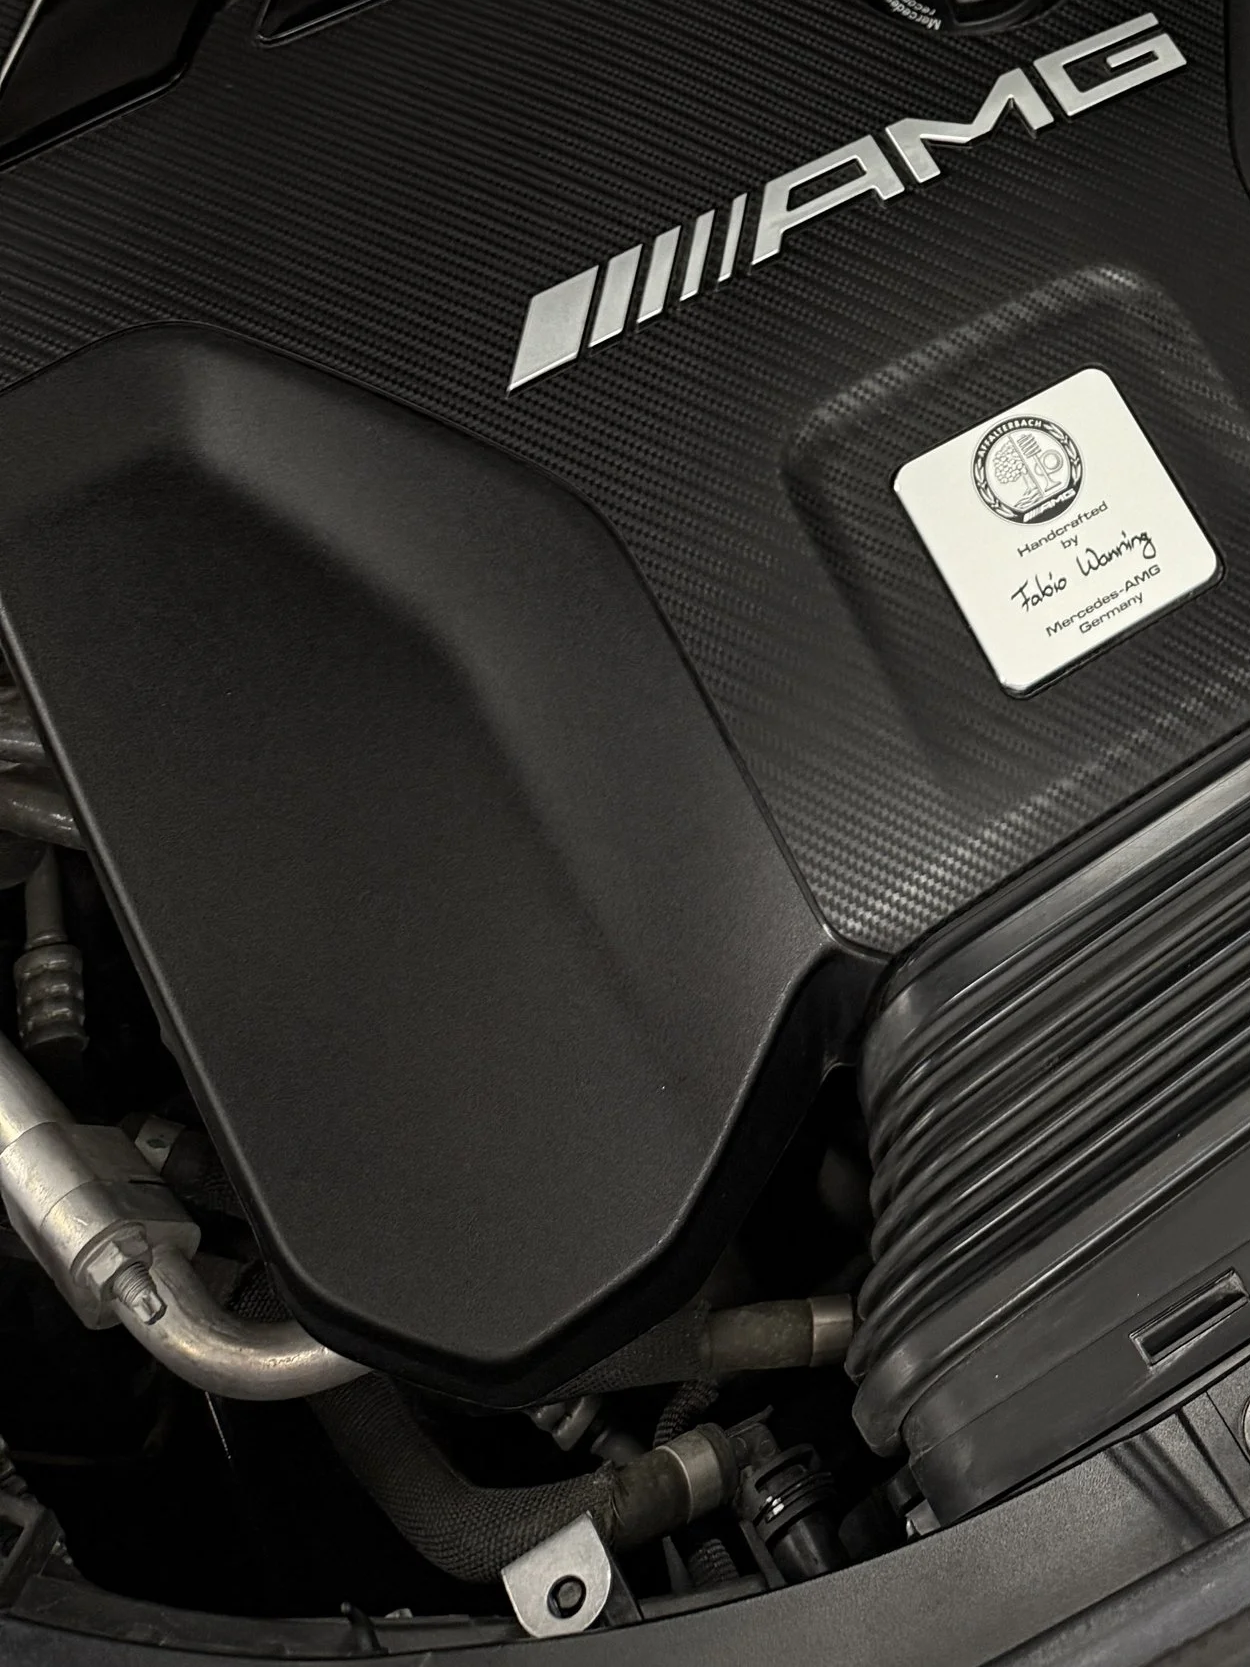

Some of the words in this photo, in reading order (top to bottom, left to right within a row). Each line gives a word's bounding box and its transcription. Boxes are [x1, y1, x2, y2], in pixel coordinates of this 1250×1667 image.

[750, 11, 1188, 267] AMG
[977, 418, 1042, 458] AFFALTERBACH
[1017, 500, 1109, 558] Handcrafted
[1060, 534, 1079, 550] by
[1011, 571, 1067, 612] Fabio
[1045, 564, 1162, 637] Mercedes-AMG
[1078, 592, 1144, 634] Germany
